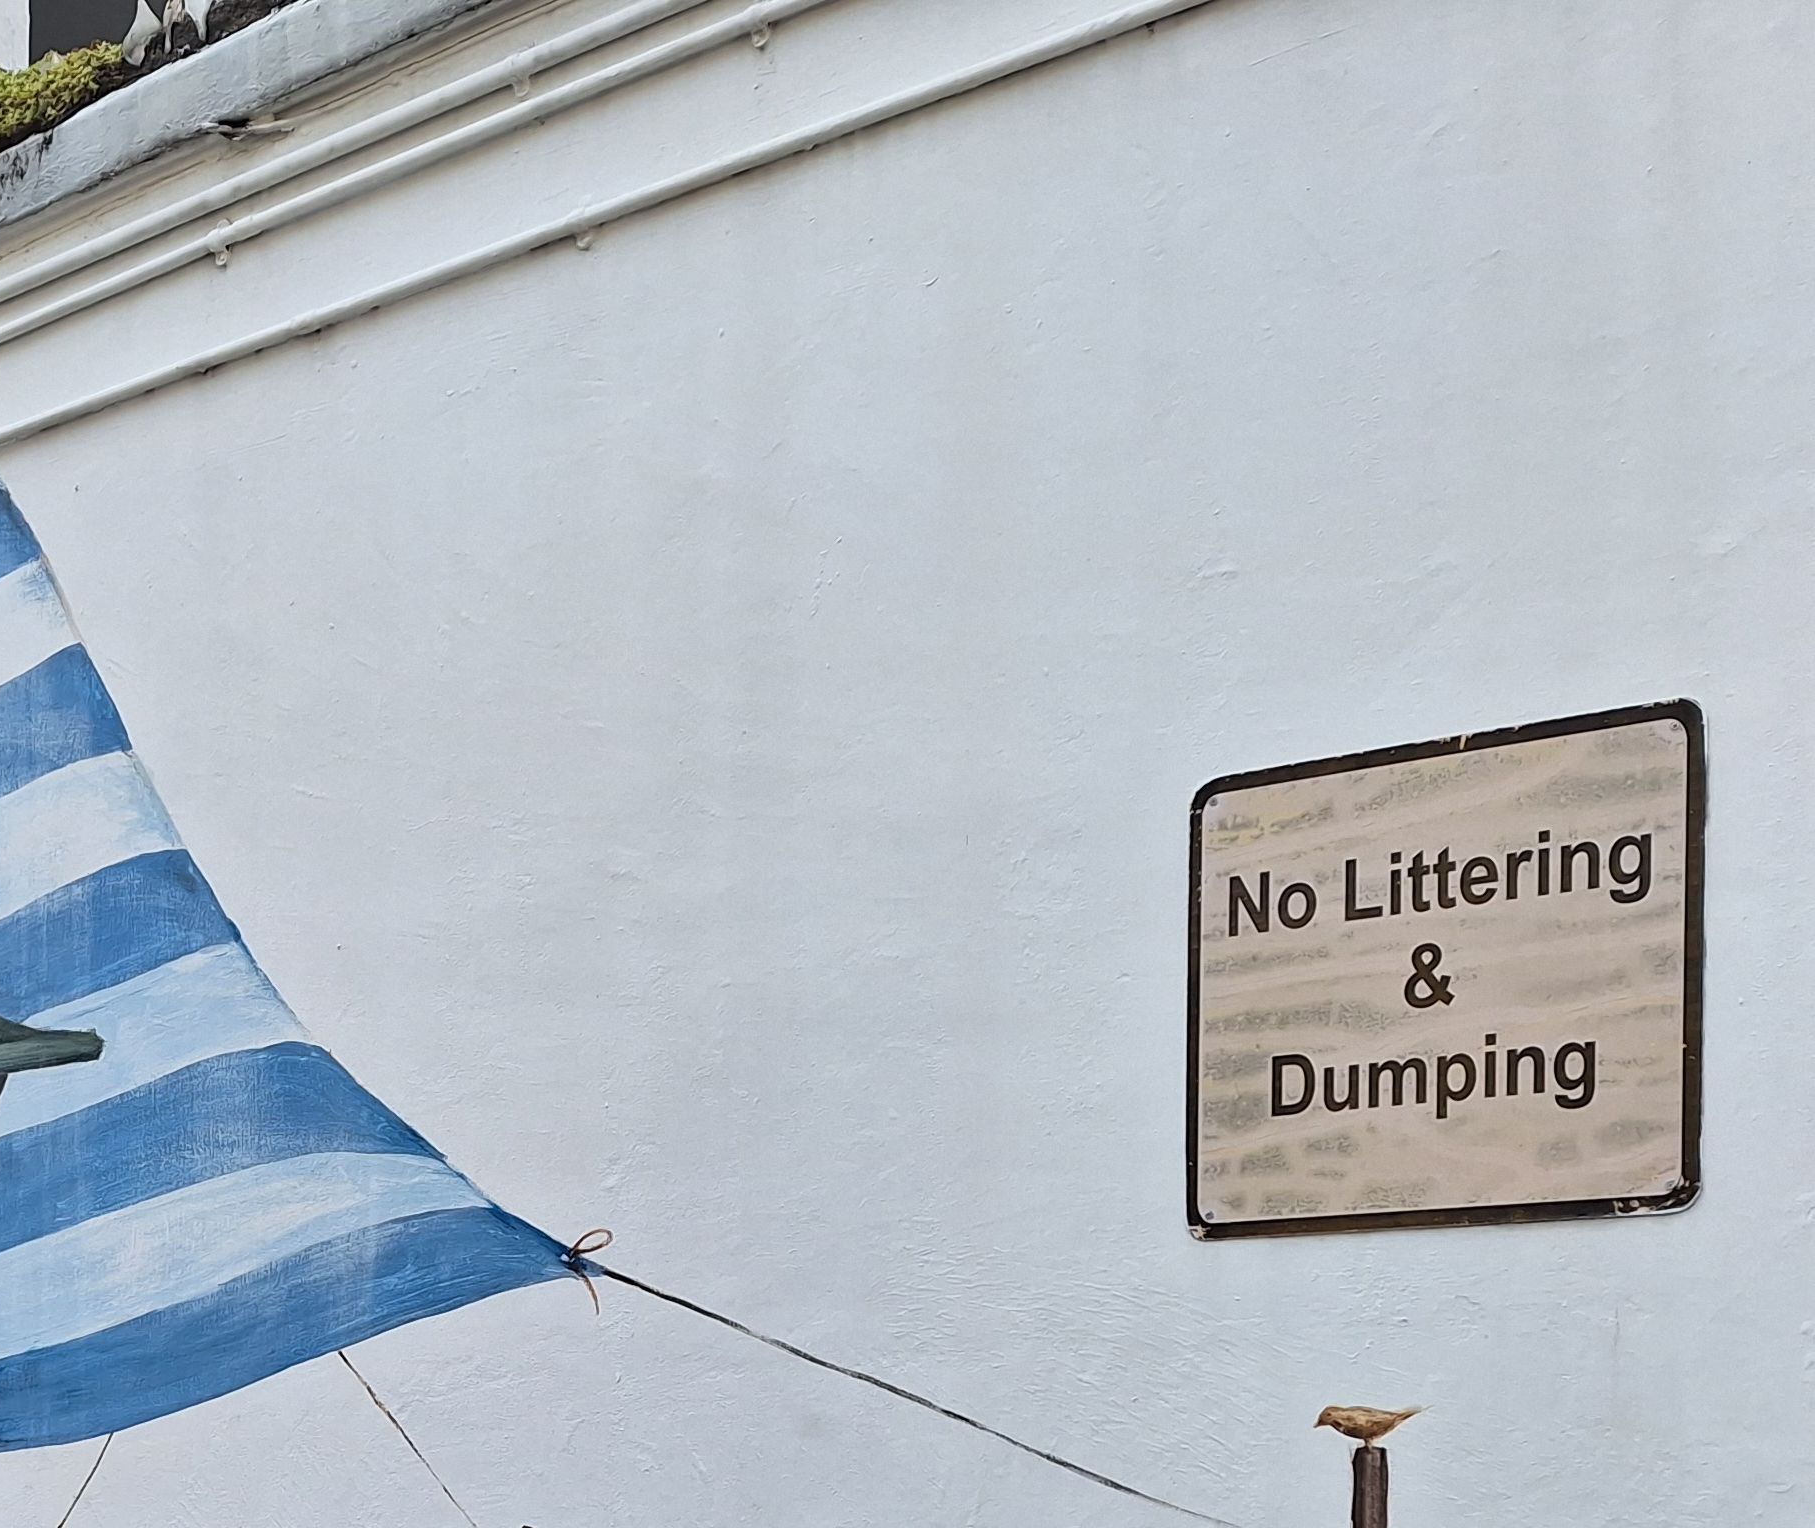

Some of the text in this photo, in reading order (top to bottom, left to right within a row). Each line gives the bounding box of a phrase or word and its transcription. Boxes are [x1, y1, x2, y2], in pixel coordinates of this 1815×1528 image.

[1227, 829, 1653, 937] No Littering
[1403, 942, 1455, 1009] &
[1270, 1034, 1597, 1119] Dumping
